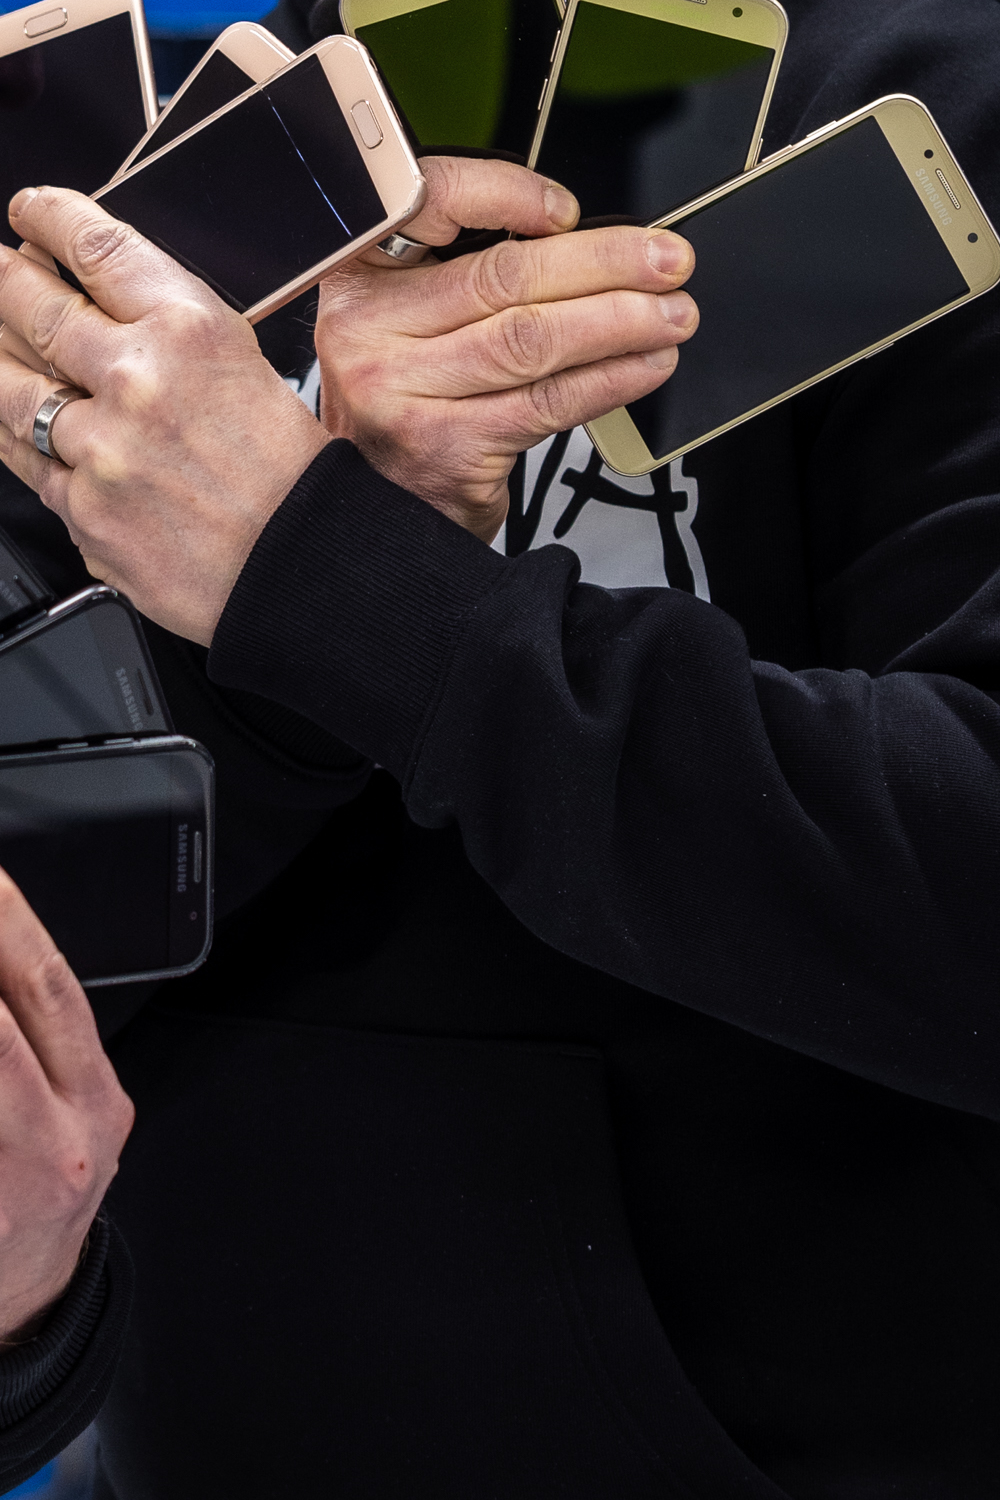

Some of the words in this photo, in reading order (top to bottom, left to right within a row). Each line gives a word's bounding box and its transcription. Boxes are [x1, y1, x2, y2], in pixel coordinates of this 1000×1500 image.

[915, 167, 953, 226] SAMSUNG
[115, 667, 144, 731] SAMSUNG
[177, 823, 189, 893] SAMSUNG
